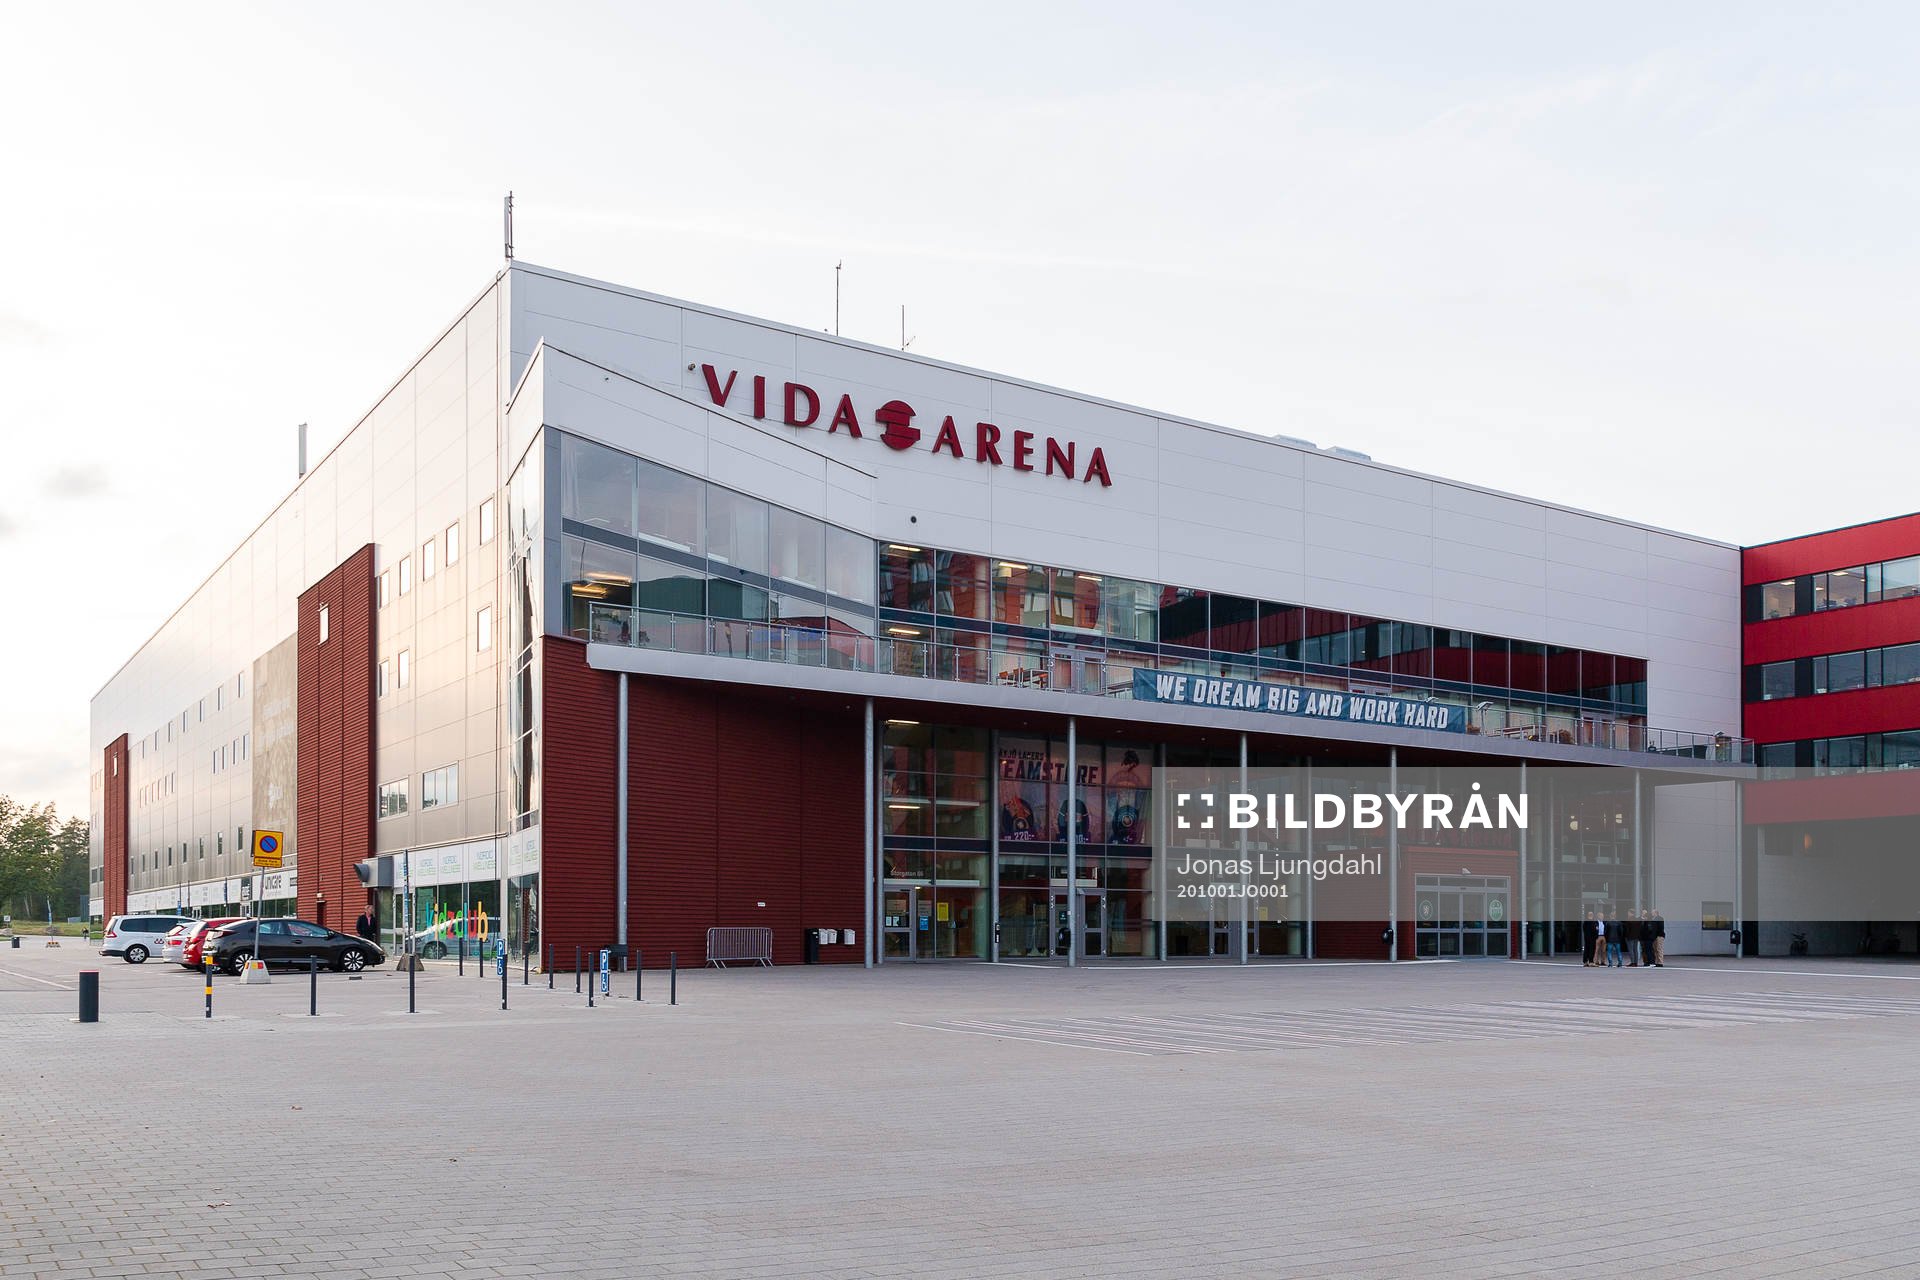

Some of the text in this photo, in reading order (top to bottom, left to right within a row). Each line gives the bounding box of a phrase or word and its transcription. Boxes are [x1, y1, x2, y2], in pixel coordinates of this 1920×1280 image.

[701, 363, 1113, 487] VIDA ARENA
[1156, 674, 1449, 729] WE DREAM BIG AND WORK HARD
[425, 899, 489, 942] kidzclub
